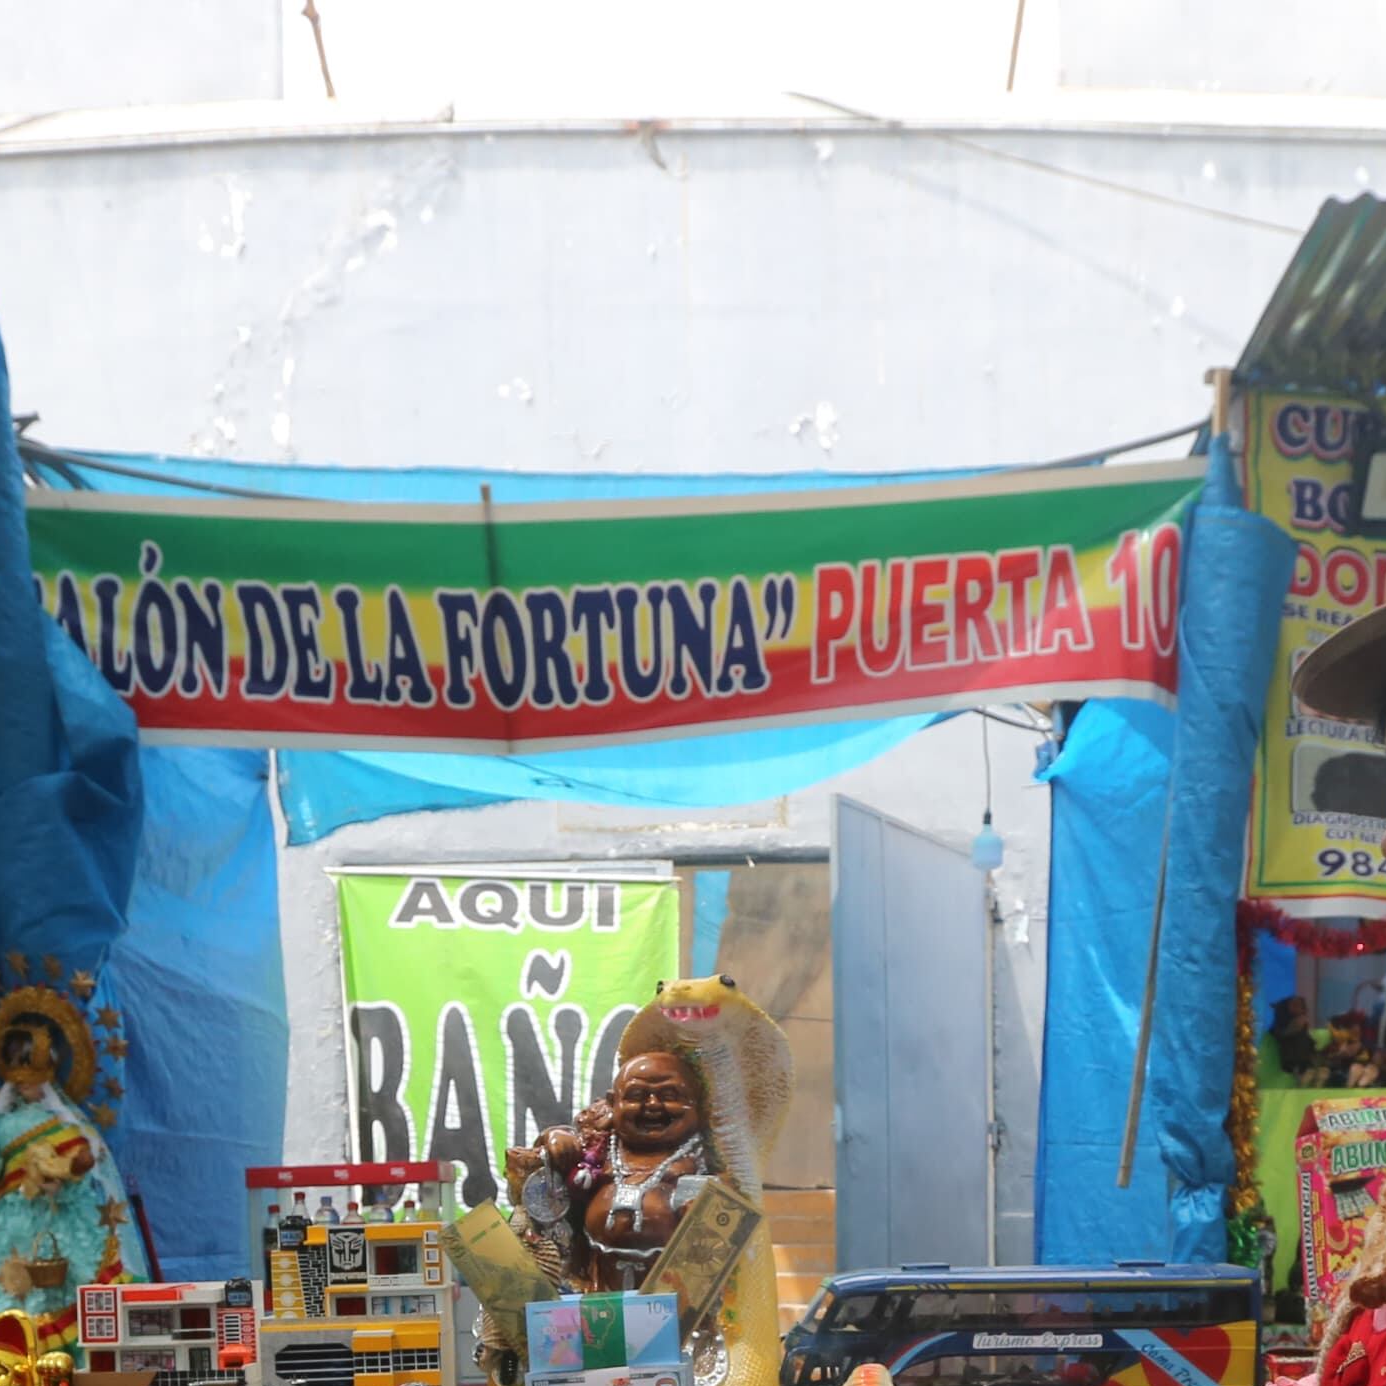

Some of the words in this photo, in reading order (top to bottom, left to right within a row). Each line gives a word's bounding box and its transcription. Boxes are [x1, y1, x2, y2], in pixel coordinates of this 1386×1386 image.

[234, 582, 333, 700] DE
[334, 586, 435, 704] LA
[814, 543, 1095, 685] PUERTA
[1110, 522, 1183, 659] 10
[394, 880, 621, 928] AQUI
[975, 1332, 1036, 1348] Turismo
[1041, 1331, 1101, 1351] Express
